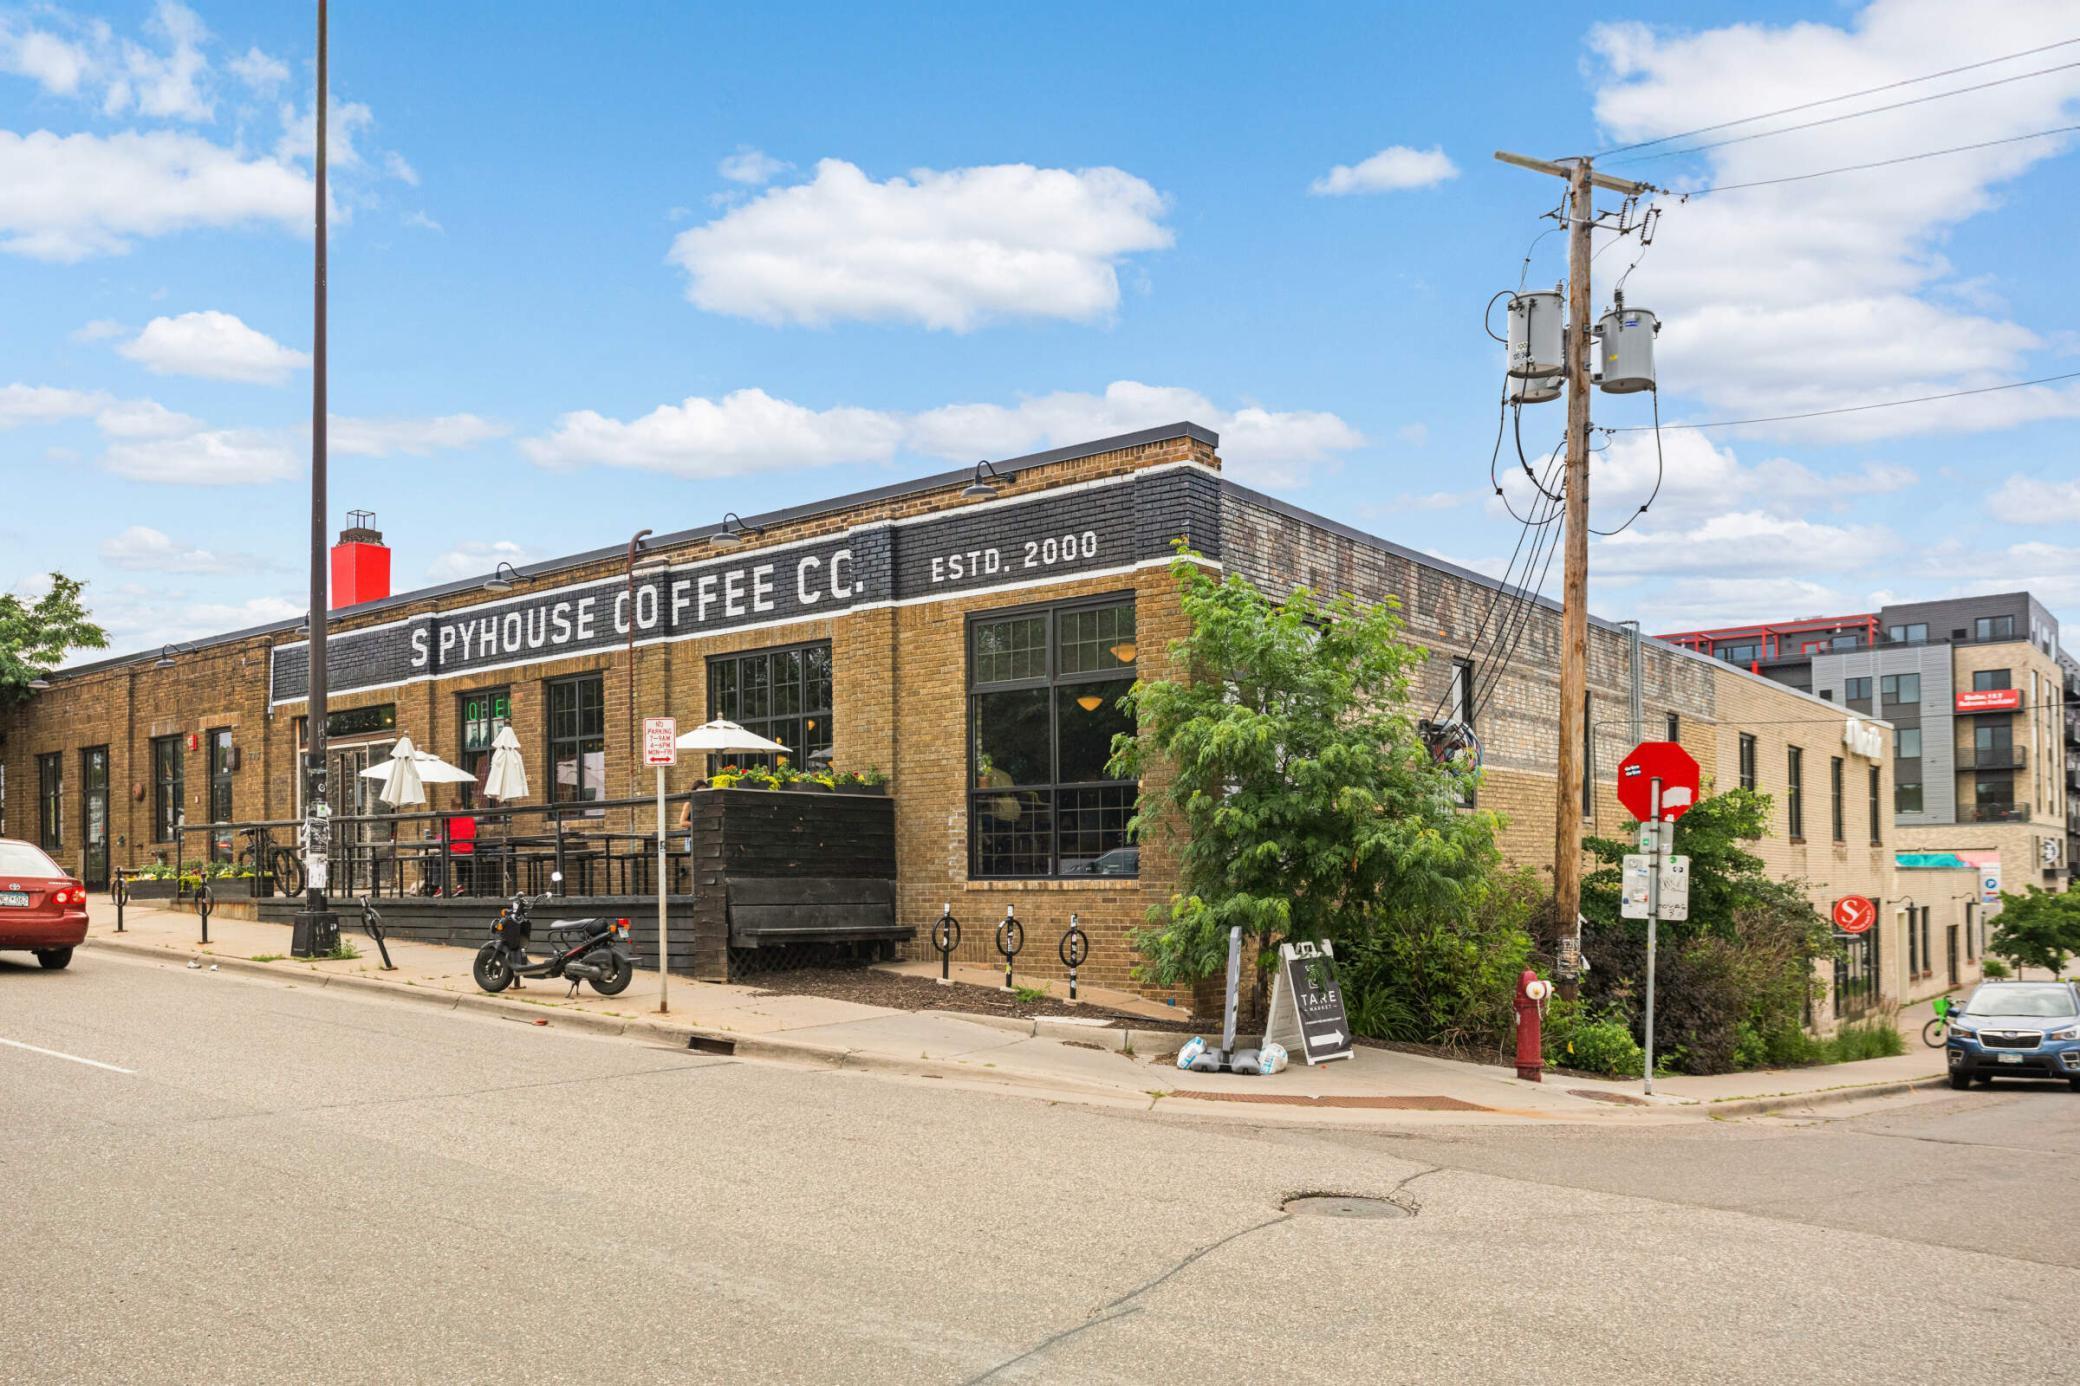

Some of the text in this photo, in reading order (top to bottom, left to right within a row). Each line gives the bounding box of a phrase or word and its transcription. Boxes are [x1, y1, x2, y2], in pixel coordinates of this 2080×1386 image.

[931, 530, 1099, 583] ESTD. 2000
[410, 597, 595, 668] SPYHOUSE
[614, 564, 775, 635] COFFEE
[1300, 990, 1337, 1006] TARE
